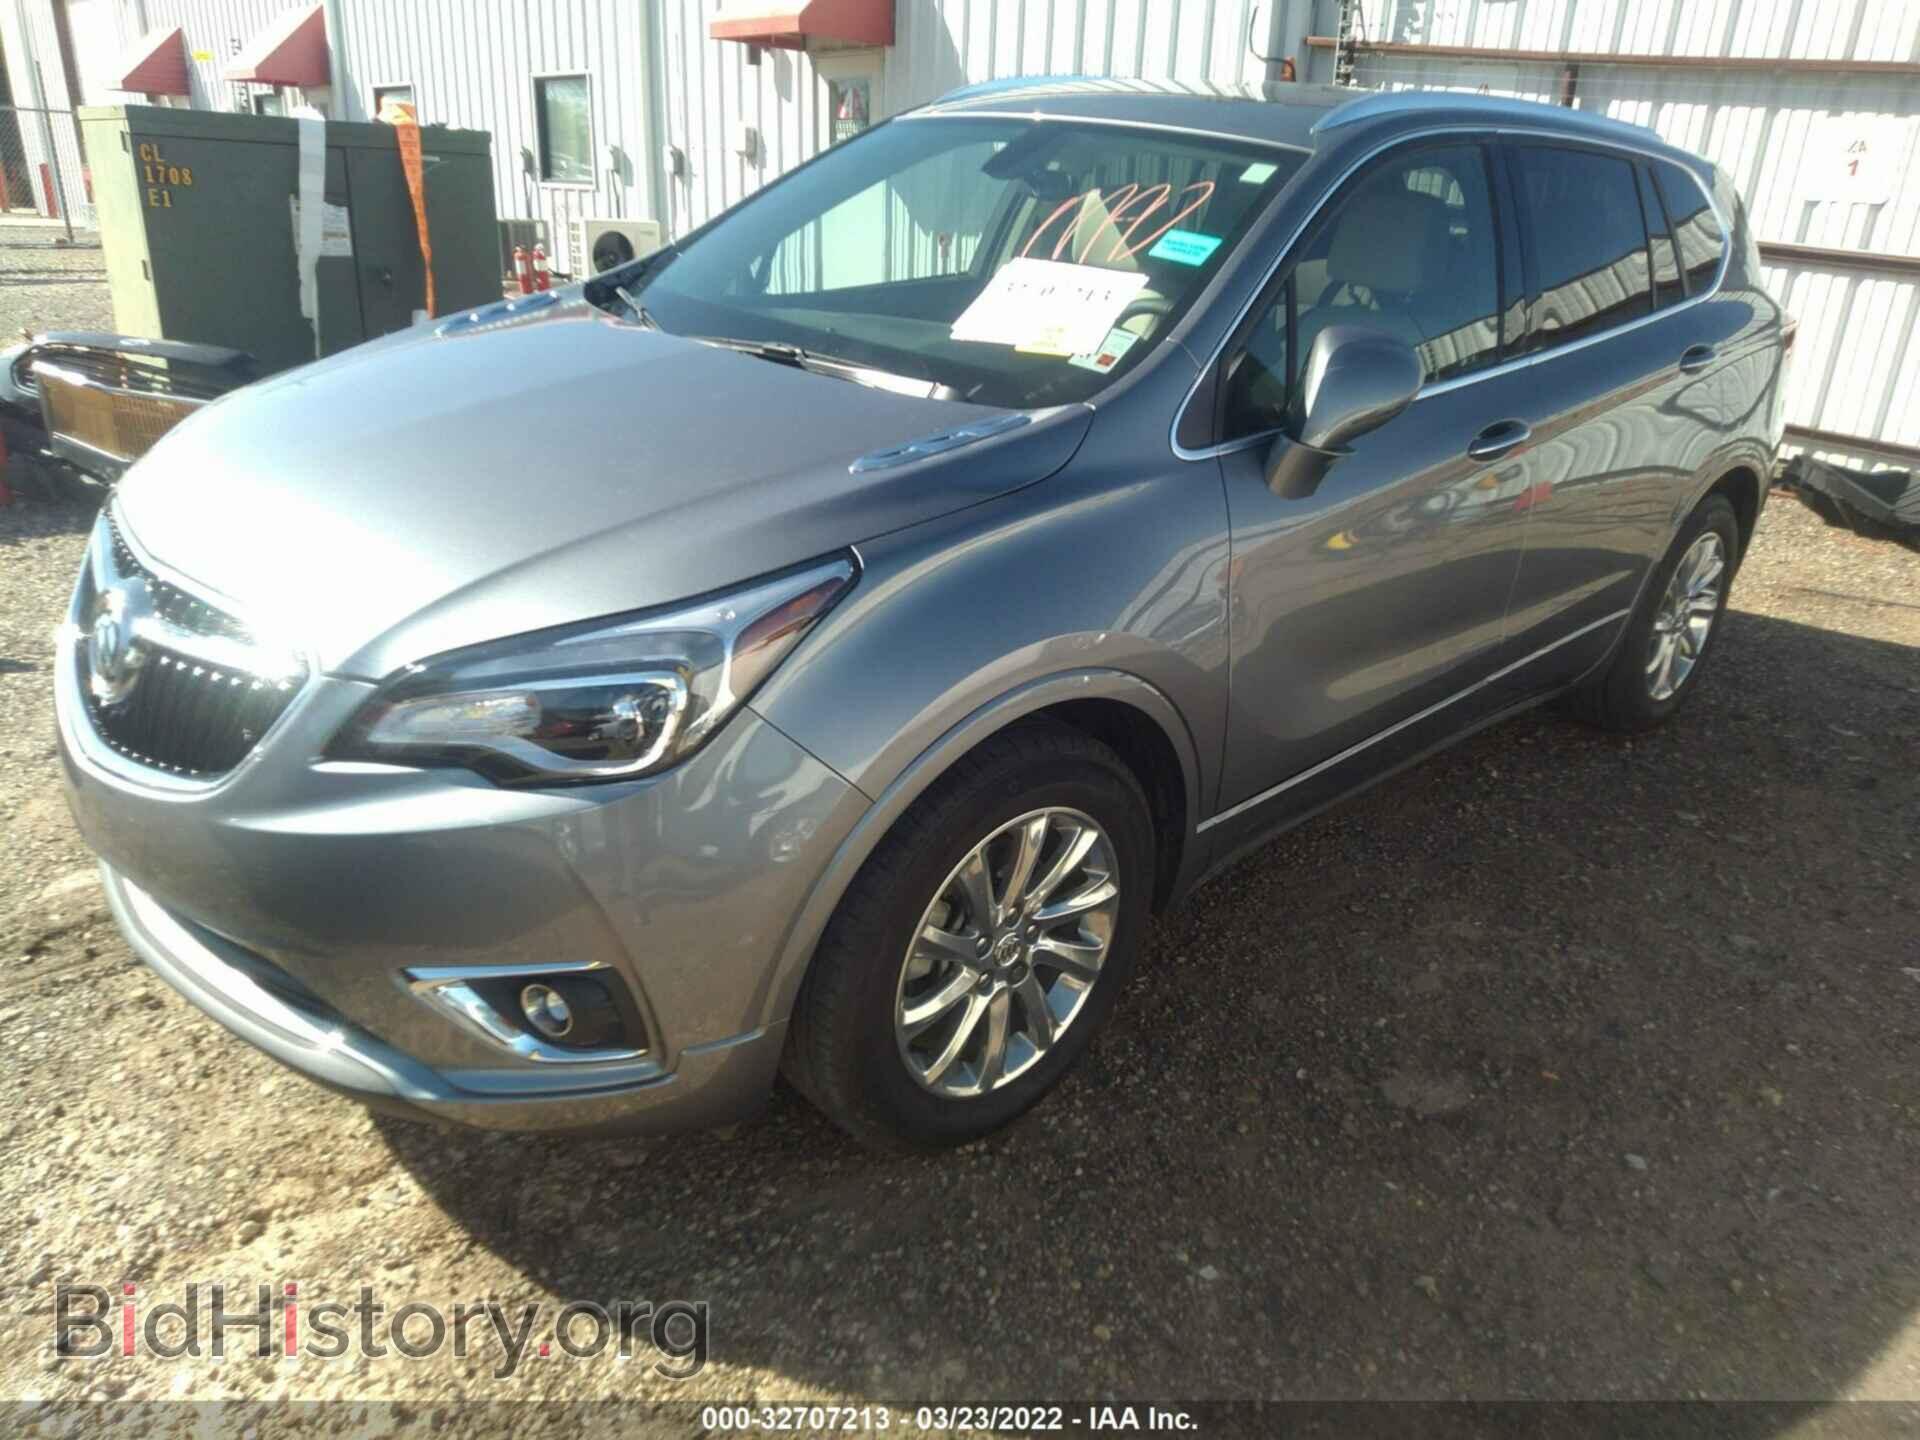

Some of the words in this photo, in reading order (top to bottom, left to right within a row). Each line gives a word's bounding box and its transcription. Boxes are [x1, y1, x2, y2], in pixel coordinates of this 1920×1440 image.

[140, 143, 166, 162] CL
[144, 166, 193, 185] 1708
[148, 188, 173, 208] E1
